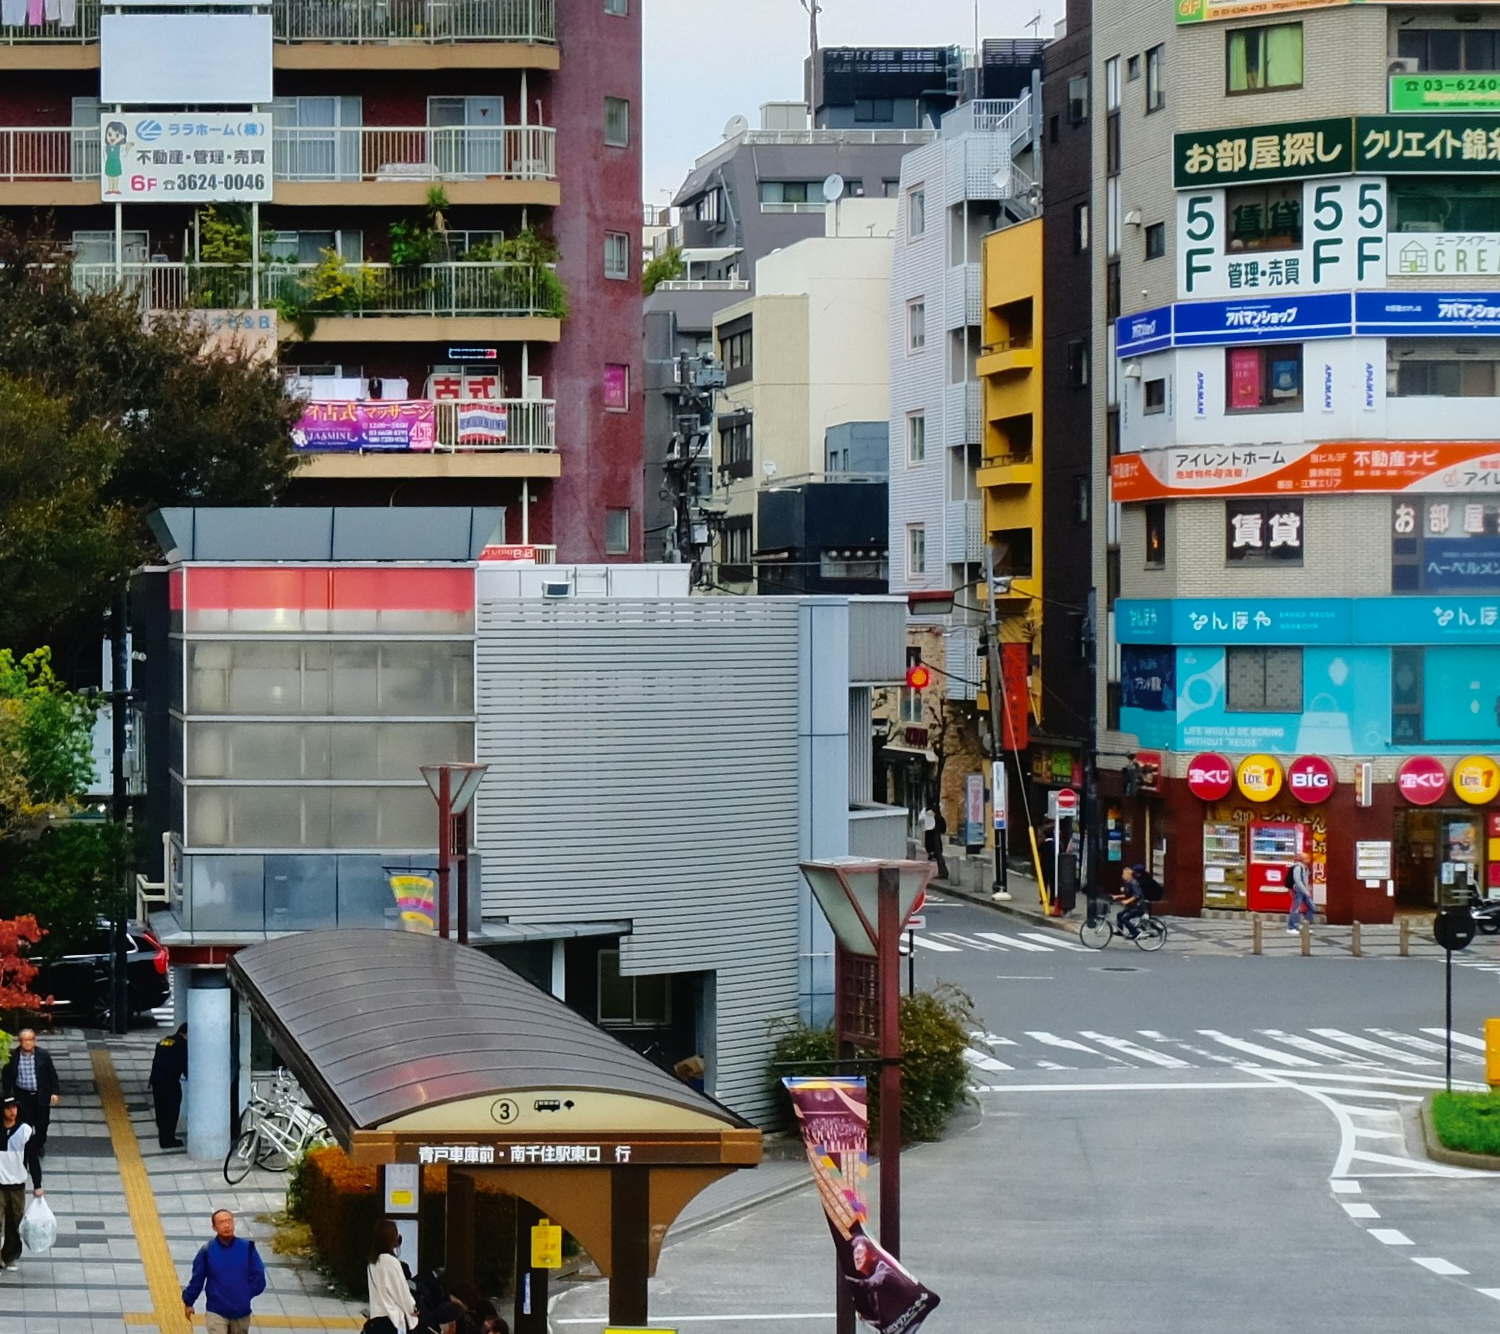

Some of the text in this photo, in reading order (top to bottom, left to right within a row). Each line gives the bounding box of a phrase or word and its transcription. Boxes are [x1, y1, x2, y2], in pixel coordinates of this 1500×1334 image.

[1179, 0, 1201, 15] 6F
[168, 122, 265, 138] ララホーム(株)
[136, 150, 265, 165] 不動産・管理・売買
[1184, 131, 1343, 174] お部屋探し
[130, 174, 265, 191] 6F 3624-0046
[1227, 257, 1300, 289] 管理・売買
[1226, 306, 1298, 326] アパマンショップ
[433, 377, 497, 399] 古式
[1175, 450, 1286, 468] アイレントホーム
[1353, 450, 1439, 467] 不動産ナビ
[1231, 513, 1301, 548] 賃貸
[1188, 610, 1272, 631] なんぼや
[1188, 768, 1230, 786] 宝くじ
[1292, 765, 1329, 788] BIG
[1399, 769, 1445, 788] 宝くじ
[418, 1145, 632, 1164] 青戸車庫前・南千住駅東口 行
